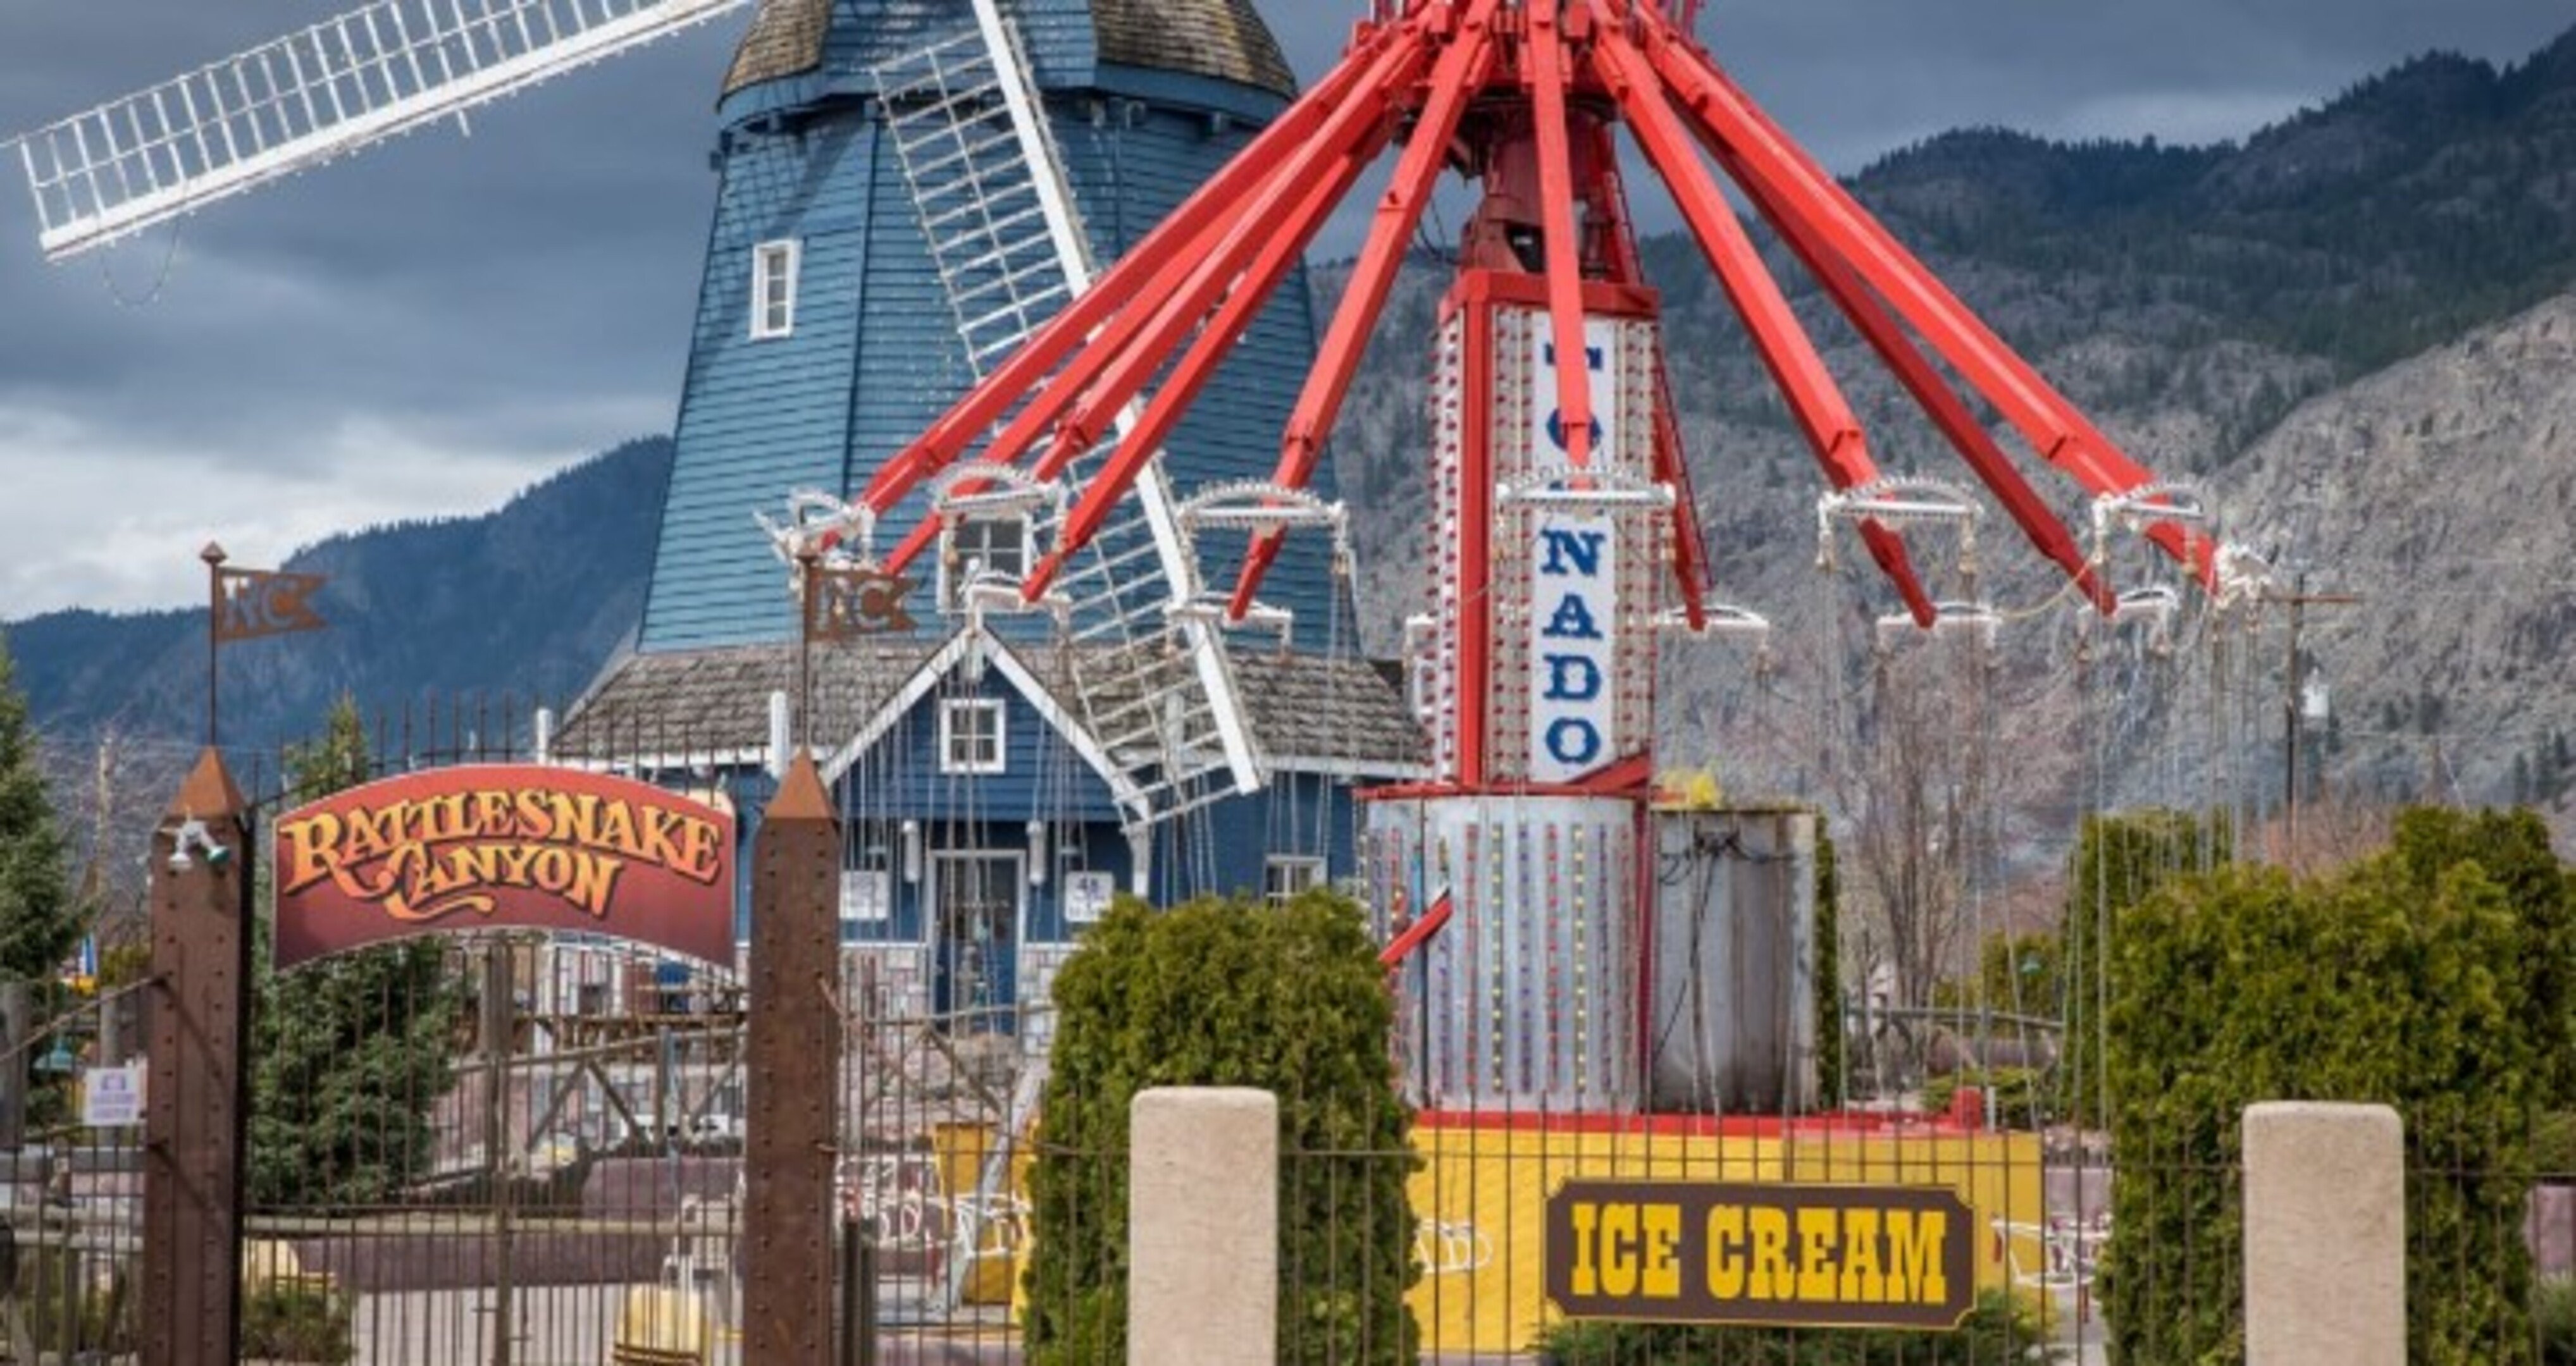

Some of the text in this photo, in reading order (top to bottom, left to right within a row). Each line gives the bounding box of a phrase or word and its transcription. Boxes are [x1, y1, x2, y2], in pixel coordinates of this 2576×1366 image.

[1540, 342, 1607, 765] ONADO
[280, 789, 721, 897] RATTLESNAKE
[378, 840, 623, 920] CANYON
[1571, 1203, 1947, 1304] ICE CREAM
